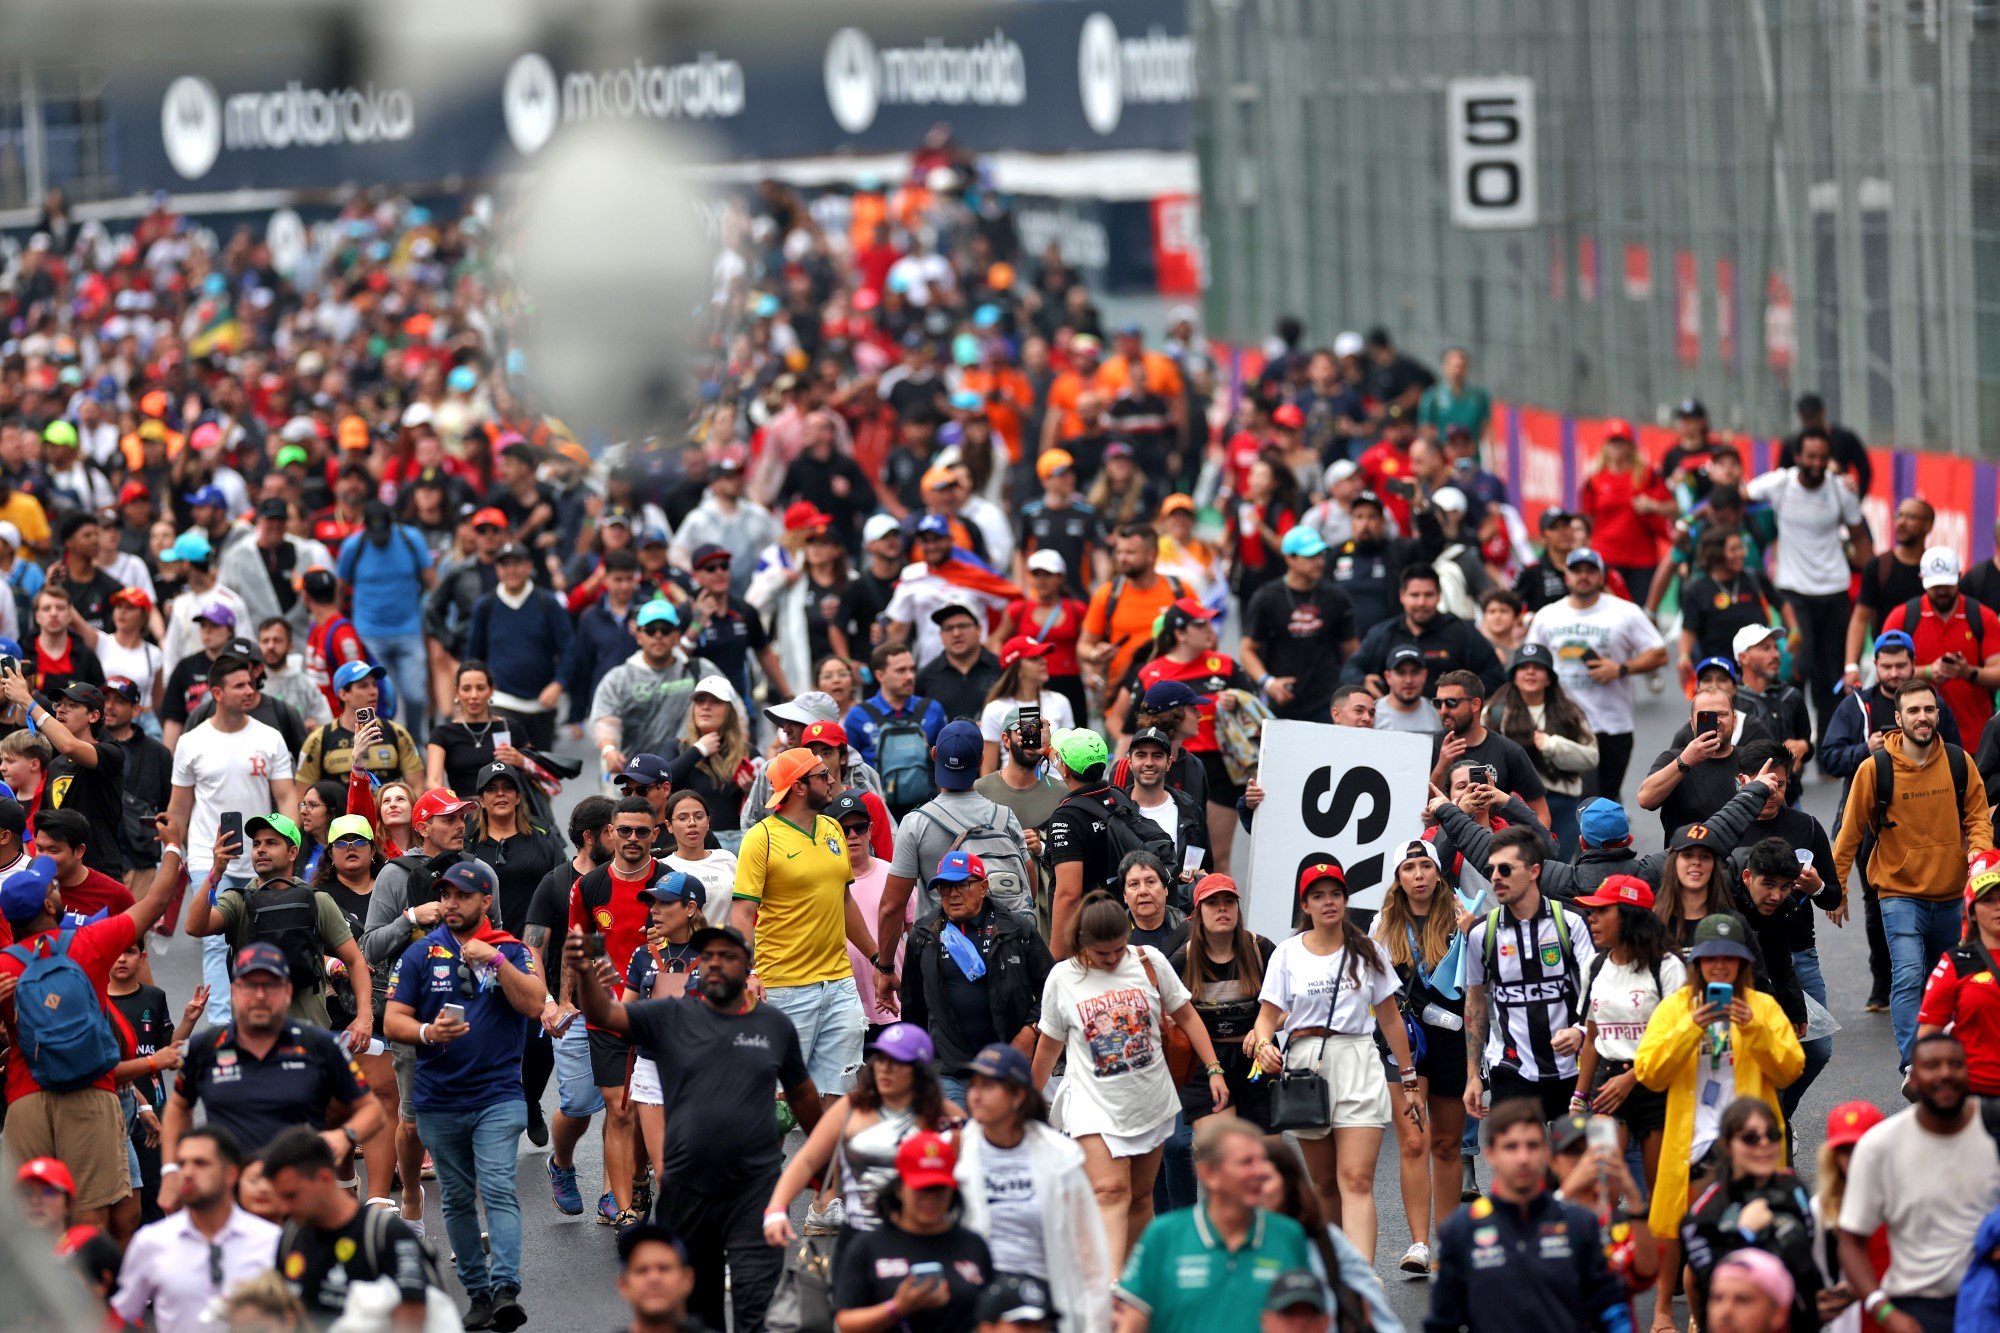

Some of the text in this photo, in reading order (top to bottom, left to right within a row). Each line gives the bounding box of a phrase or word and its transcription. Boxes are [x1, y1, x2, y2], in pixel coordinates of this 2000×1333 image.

[1465, 98, 1521, 209] 50
[1687, 824, 1708, 840] 47
[1076, 987, 1150, 1027] VERSTAPPEN
